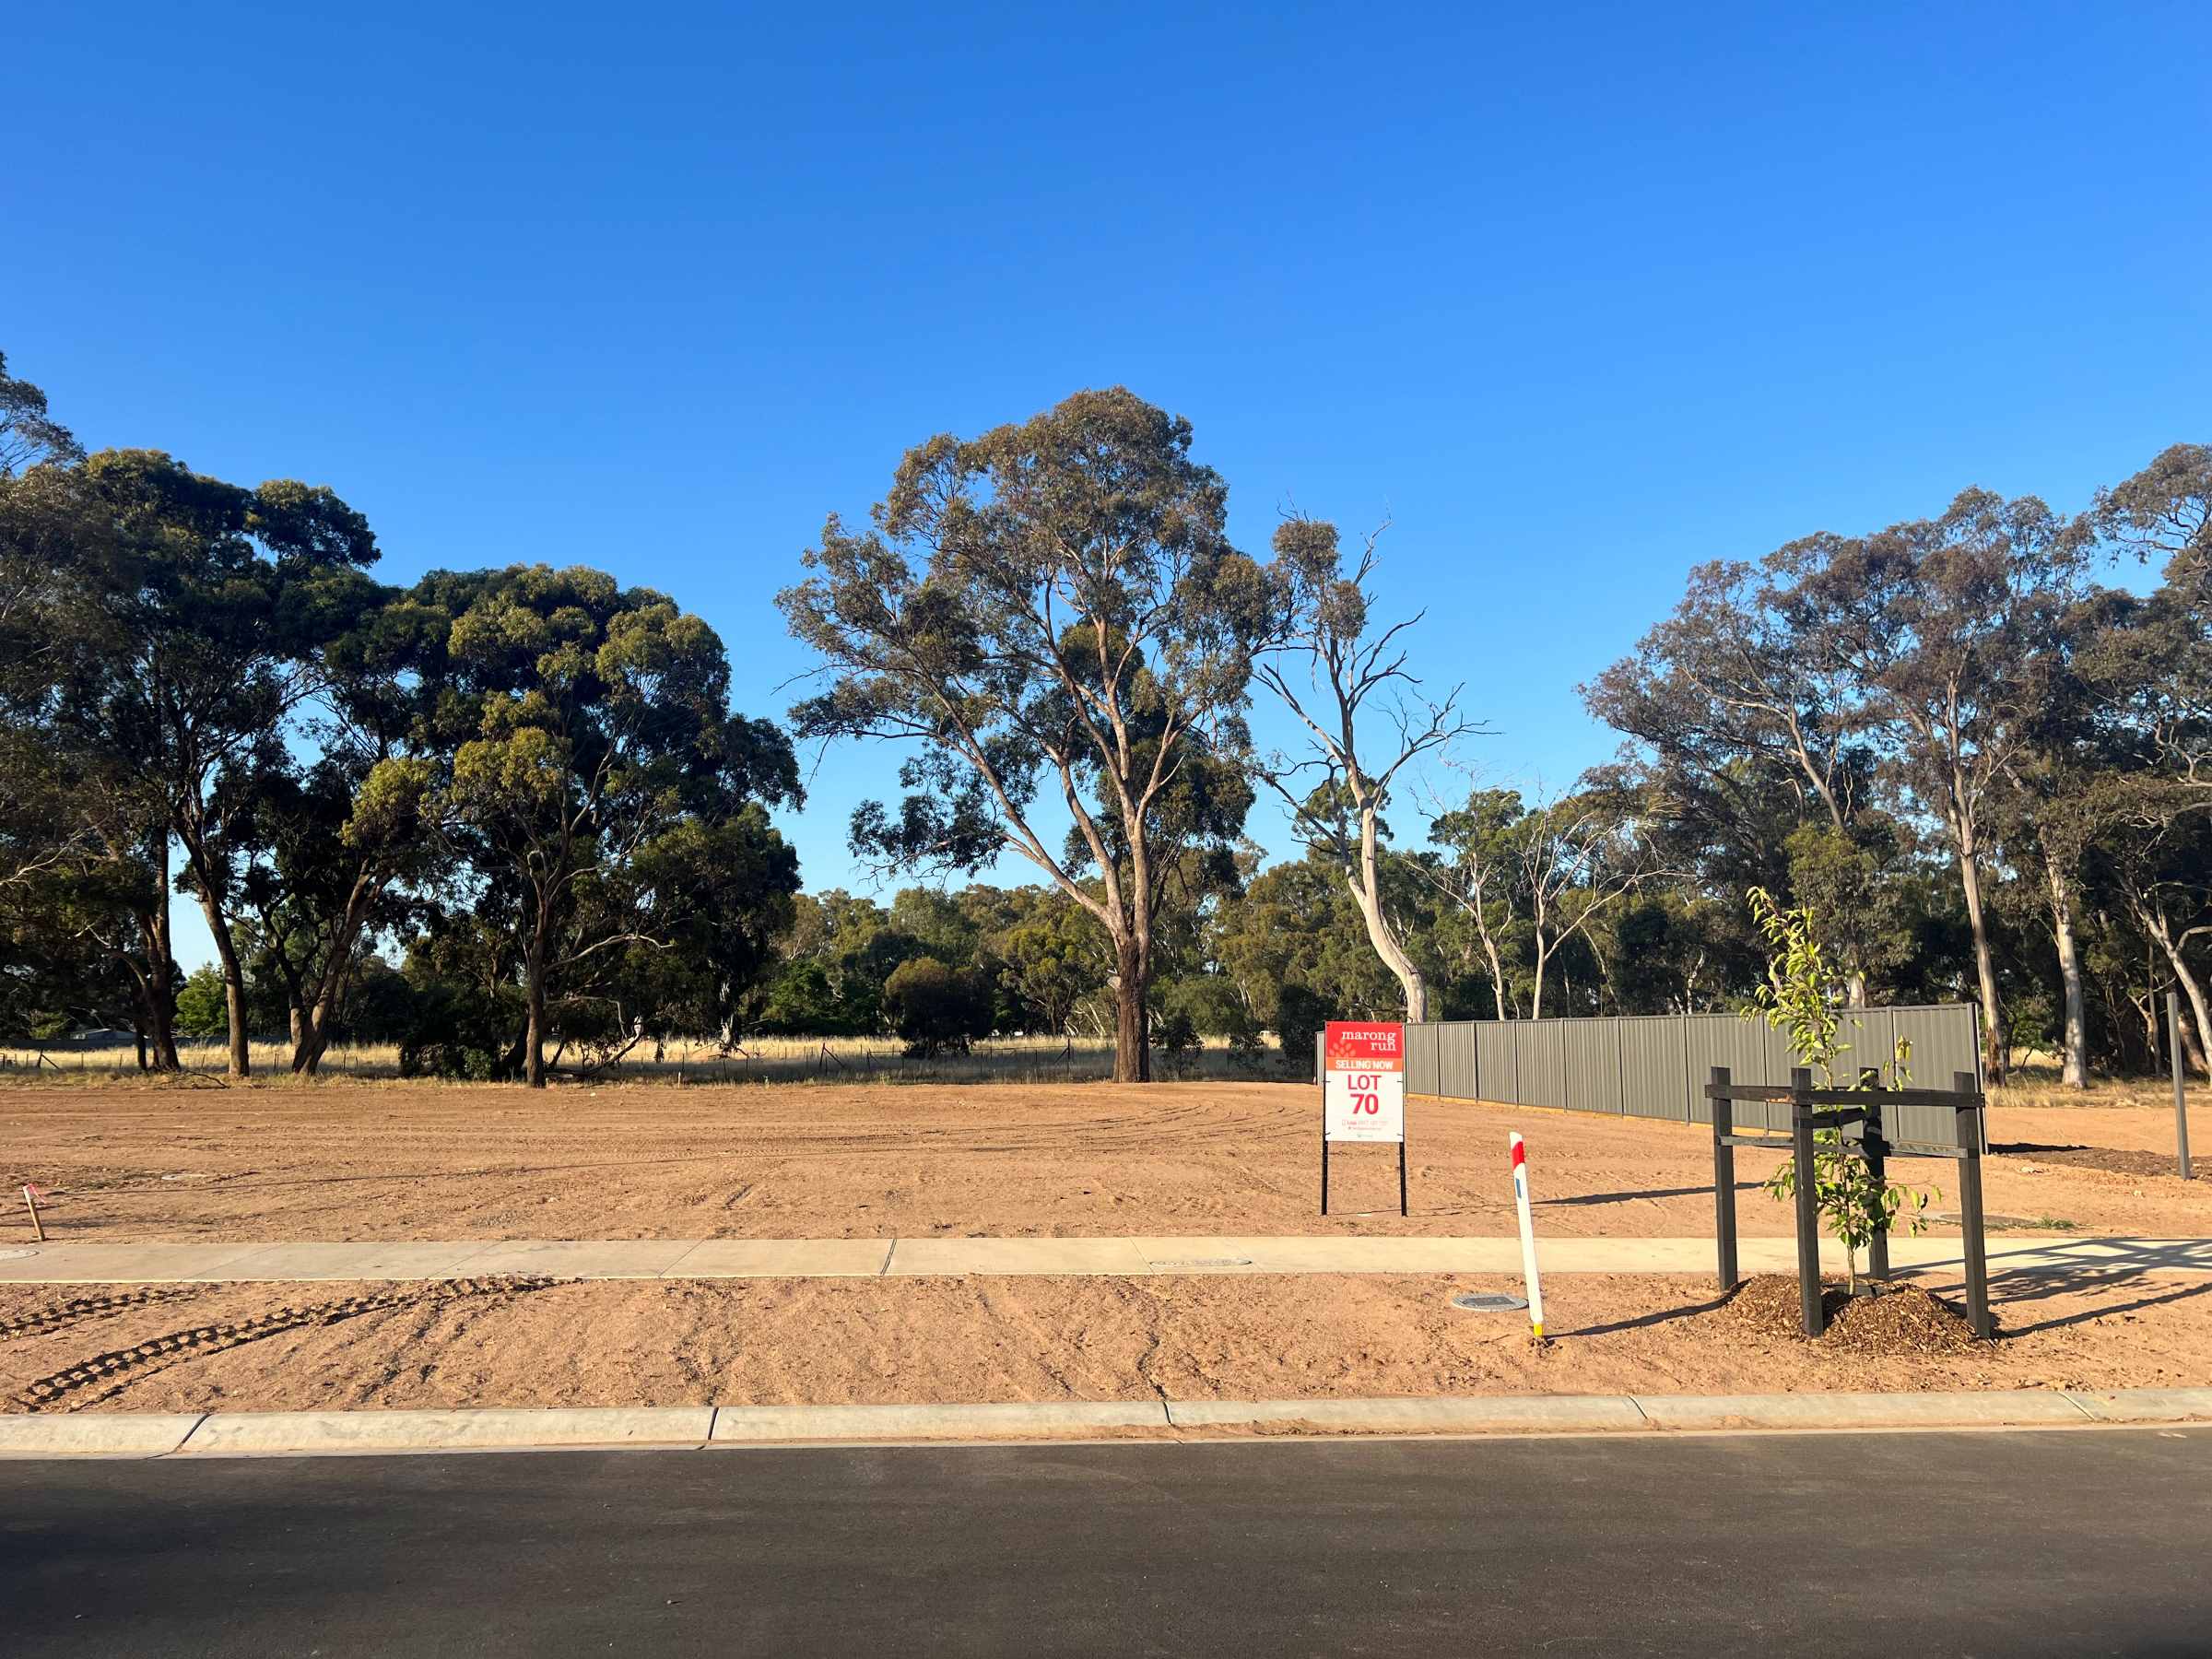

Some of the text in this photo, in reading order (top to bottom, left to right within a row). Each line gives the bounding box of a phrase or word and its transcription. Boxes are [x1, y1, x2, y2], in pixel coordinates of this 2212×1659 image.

[1342, 1030, 1396, 1043] marong
[1371, 1041, 1396, 1052] run
[1335, 1060, 1393, 1069] SELLING NOW
[1347, 1075, 1382, 1090] LOT
[1350, 1093, 1379, 1114] 70
